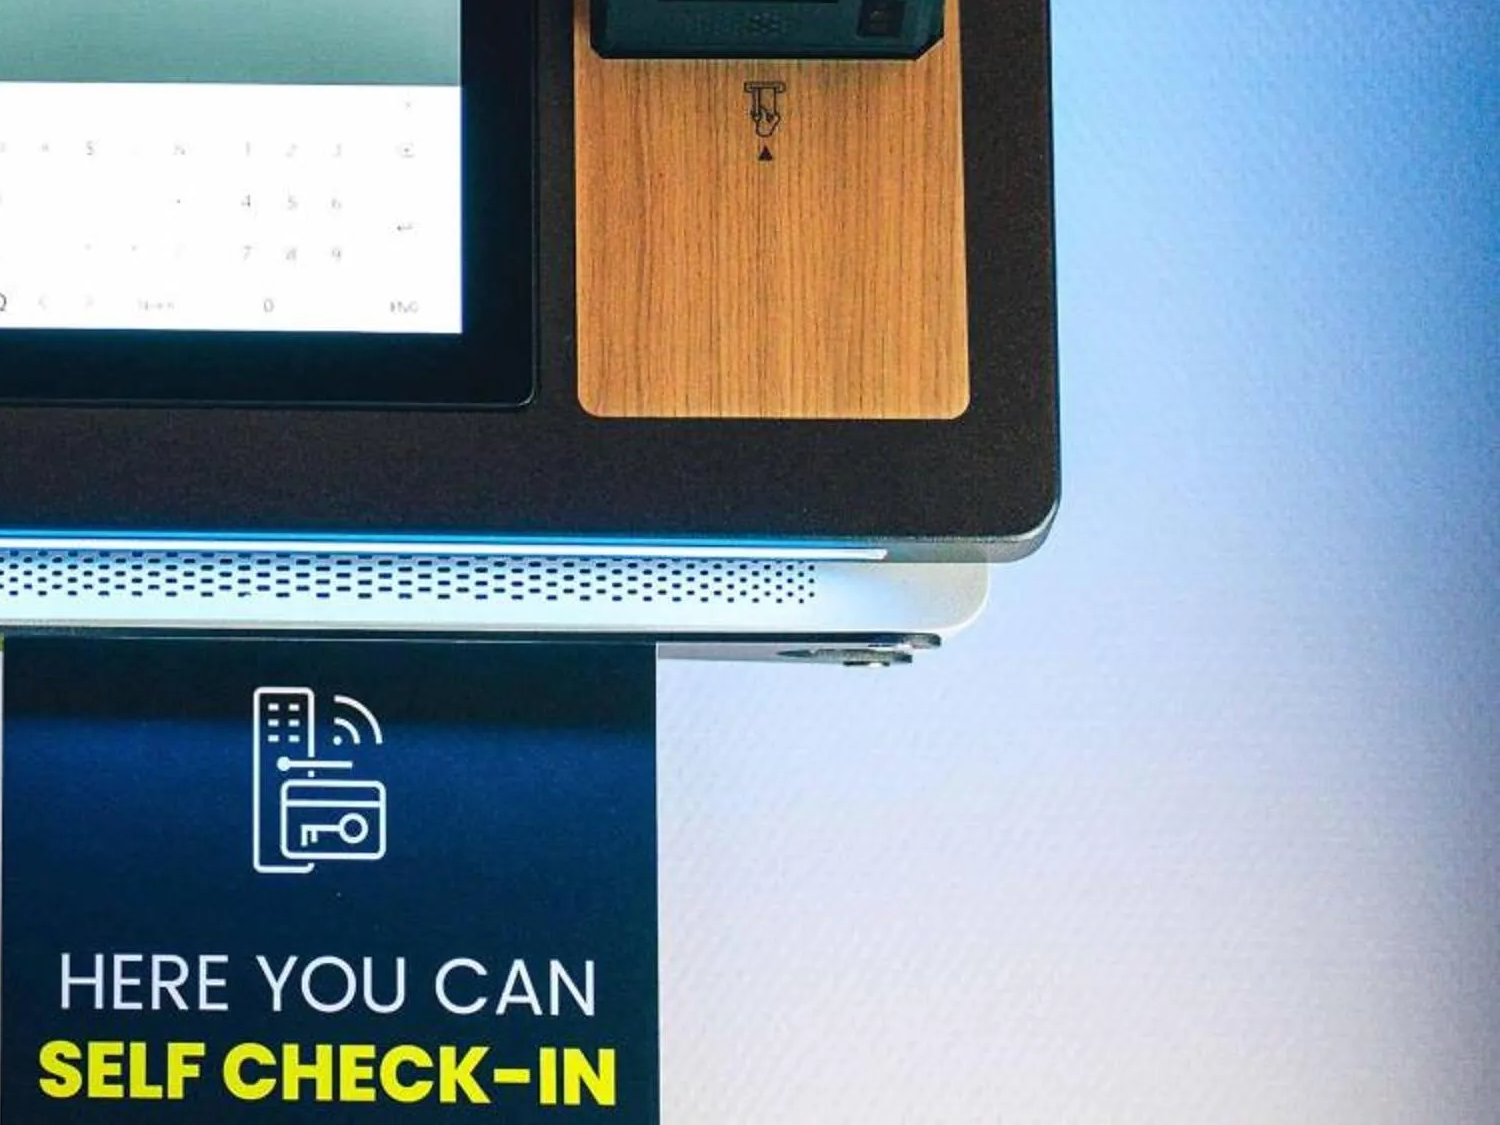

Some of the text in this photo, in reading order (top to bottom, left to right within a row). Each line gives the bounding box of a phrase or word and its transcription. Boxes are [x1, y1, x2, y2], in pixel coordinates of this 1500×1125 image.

[240, 194, 252, 209] 4
[61, 953, 595, 1017] HERE YOU CAN
[39, 1040, 616, 1106] SELF CHECK-IN
